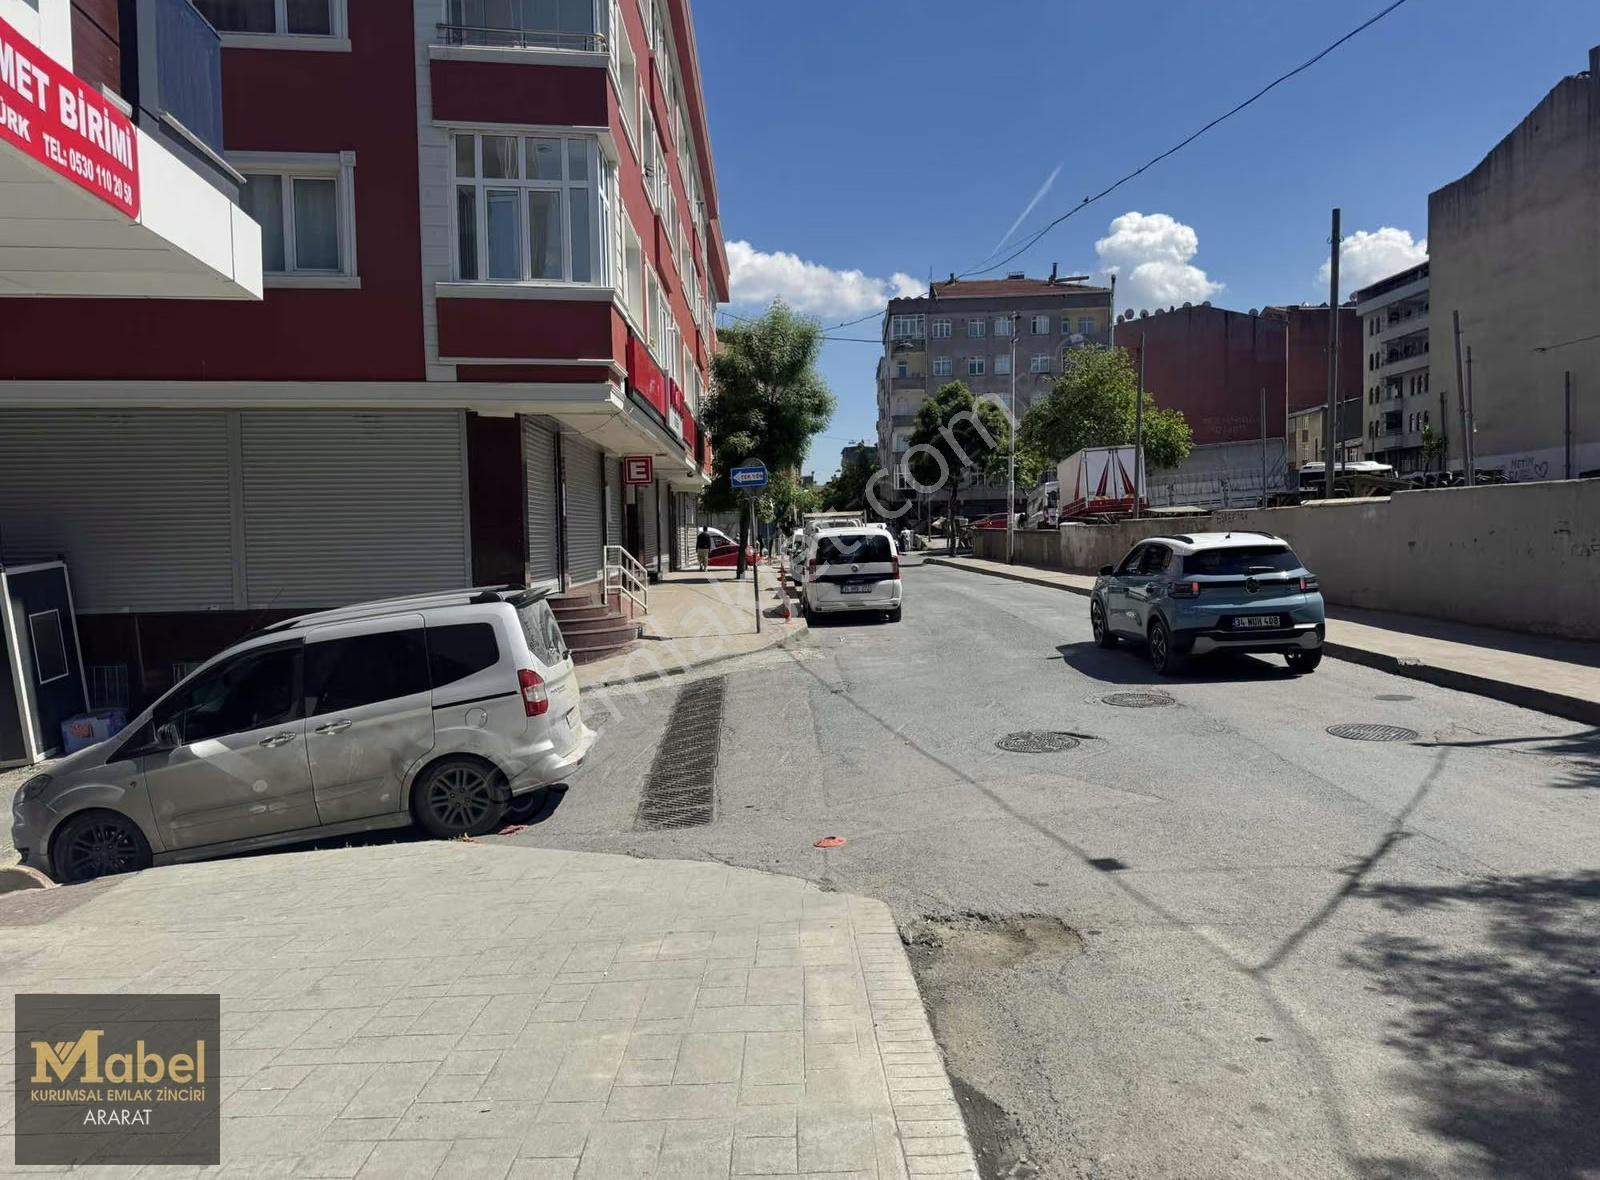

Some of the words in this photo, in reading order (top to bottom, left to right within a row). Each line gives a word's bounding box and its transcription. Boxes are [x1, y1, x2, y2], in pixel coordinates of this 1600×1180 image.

[58, 83, 133, 171] BİRİMİ
[42, 132, 68, 168] TEL:
[69, 148, 94, 182] 0530
[96, 164, 113, 192] 110
[630, 461, 647, 478] E
